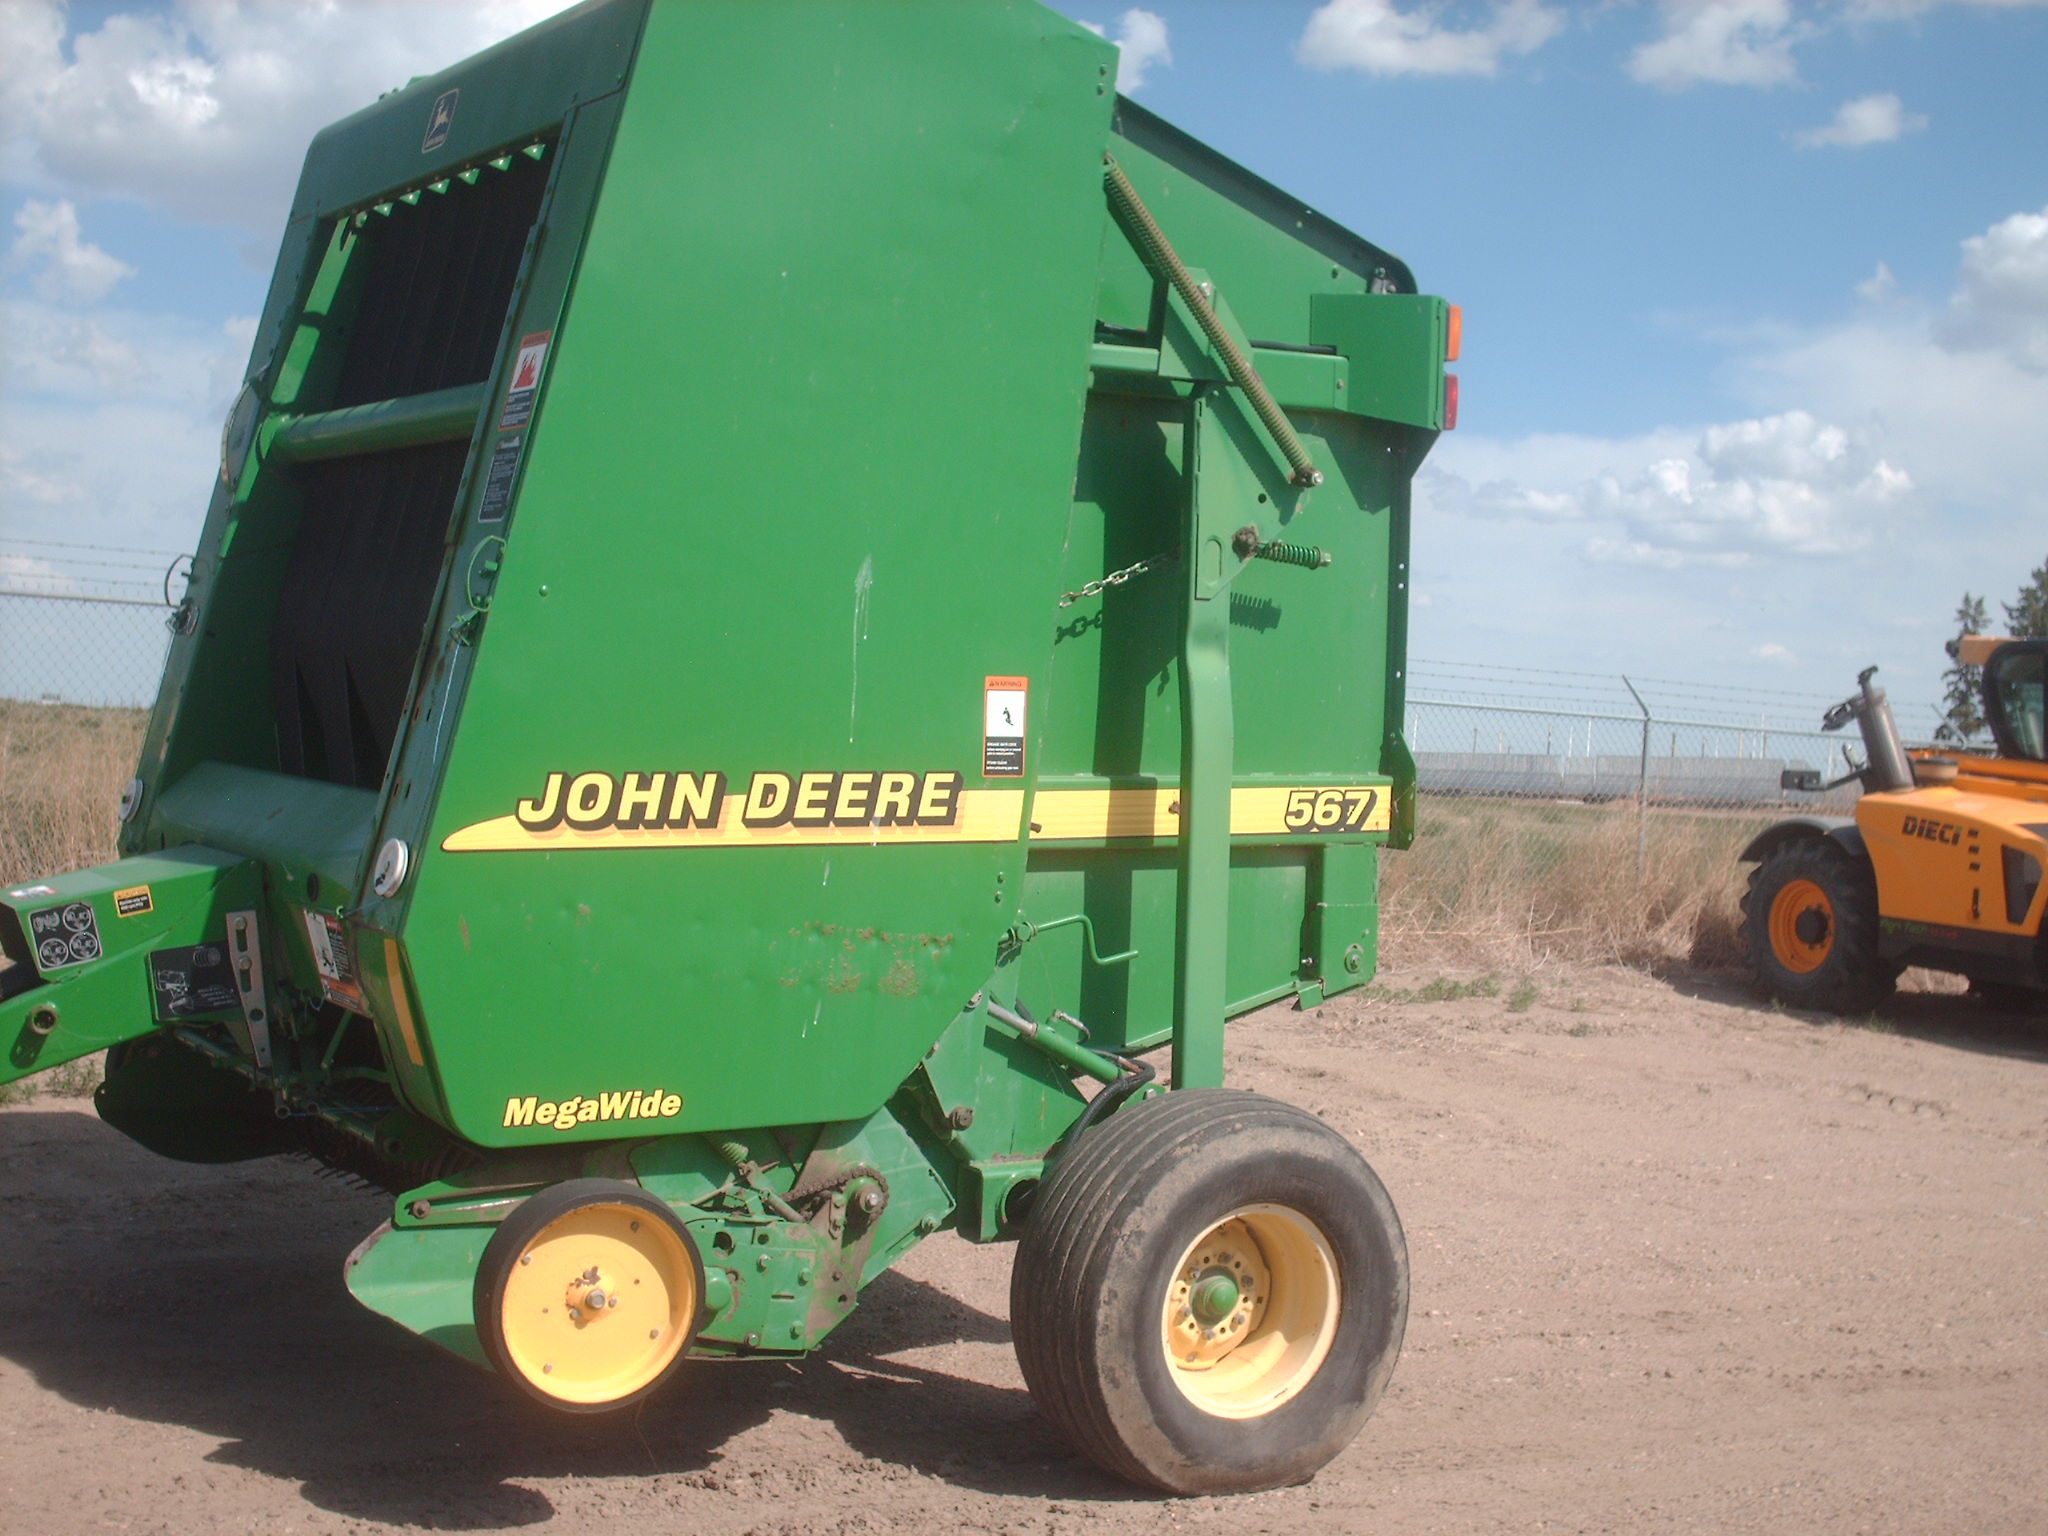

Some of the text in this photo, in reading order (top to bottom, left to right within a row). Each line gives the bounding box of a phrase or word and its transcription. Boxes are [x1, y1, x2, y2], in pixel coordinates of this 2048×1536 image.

[515, 771, 964, 832] JOHN DEERE
[1284, 789, 1377, 833] 567
[503, 1088, 683, 1131] MegaWide
